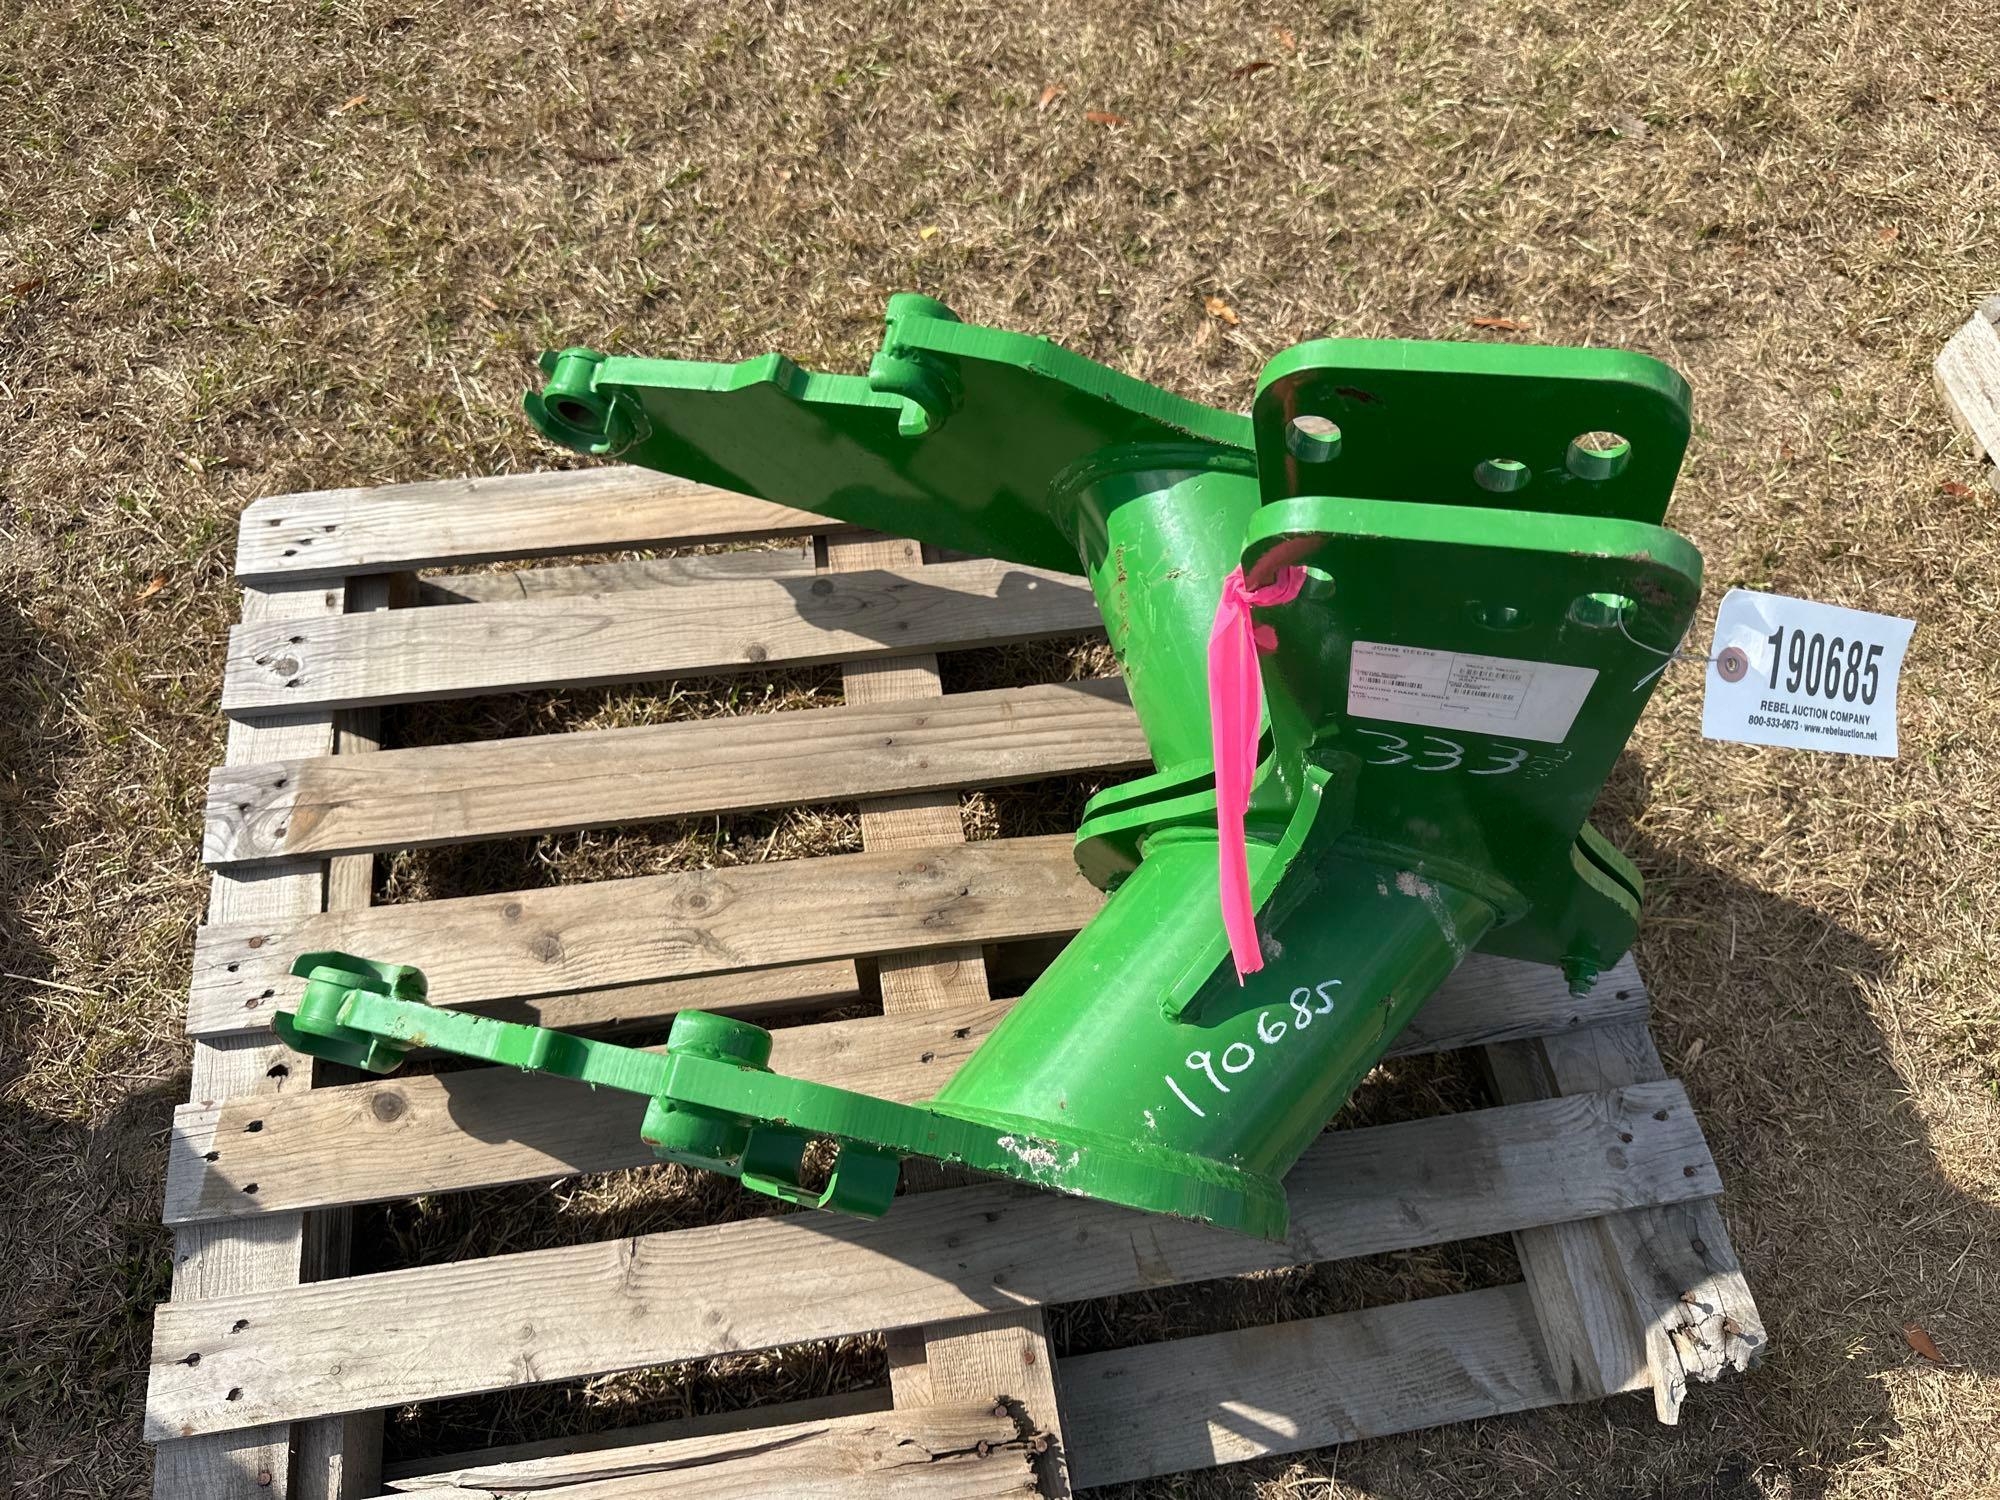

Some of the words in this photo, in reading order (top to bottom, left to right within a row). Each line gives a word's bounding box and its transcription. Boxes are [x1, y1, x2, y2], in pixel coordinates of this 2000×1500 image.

[1767, 625, 1884, 706] 190685
[1748, 714, 1799, 731] 800-533-0673
[1804, 723, 1878, 741] www.rebelauction.net
[1760, 700, 1790, 715] REBEL
[1791, 704, 1828, 720] AUCTION
[1829, 710, 1871, 726] COMPANY
[1164, 979, 1342, 1118] 190685
